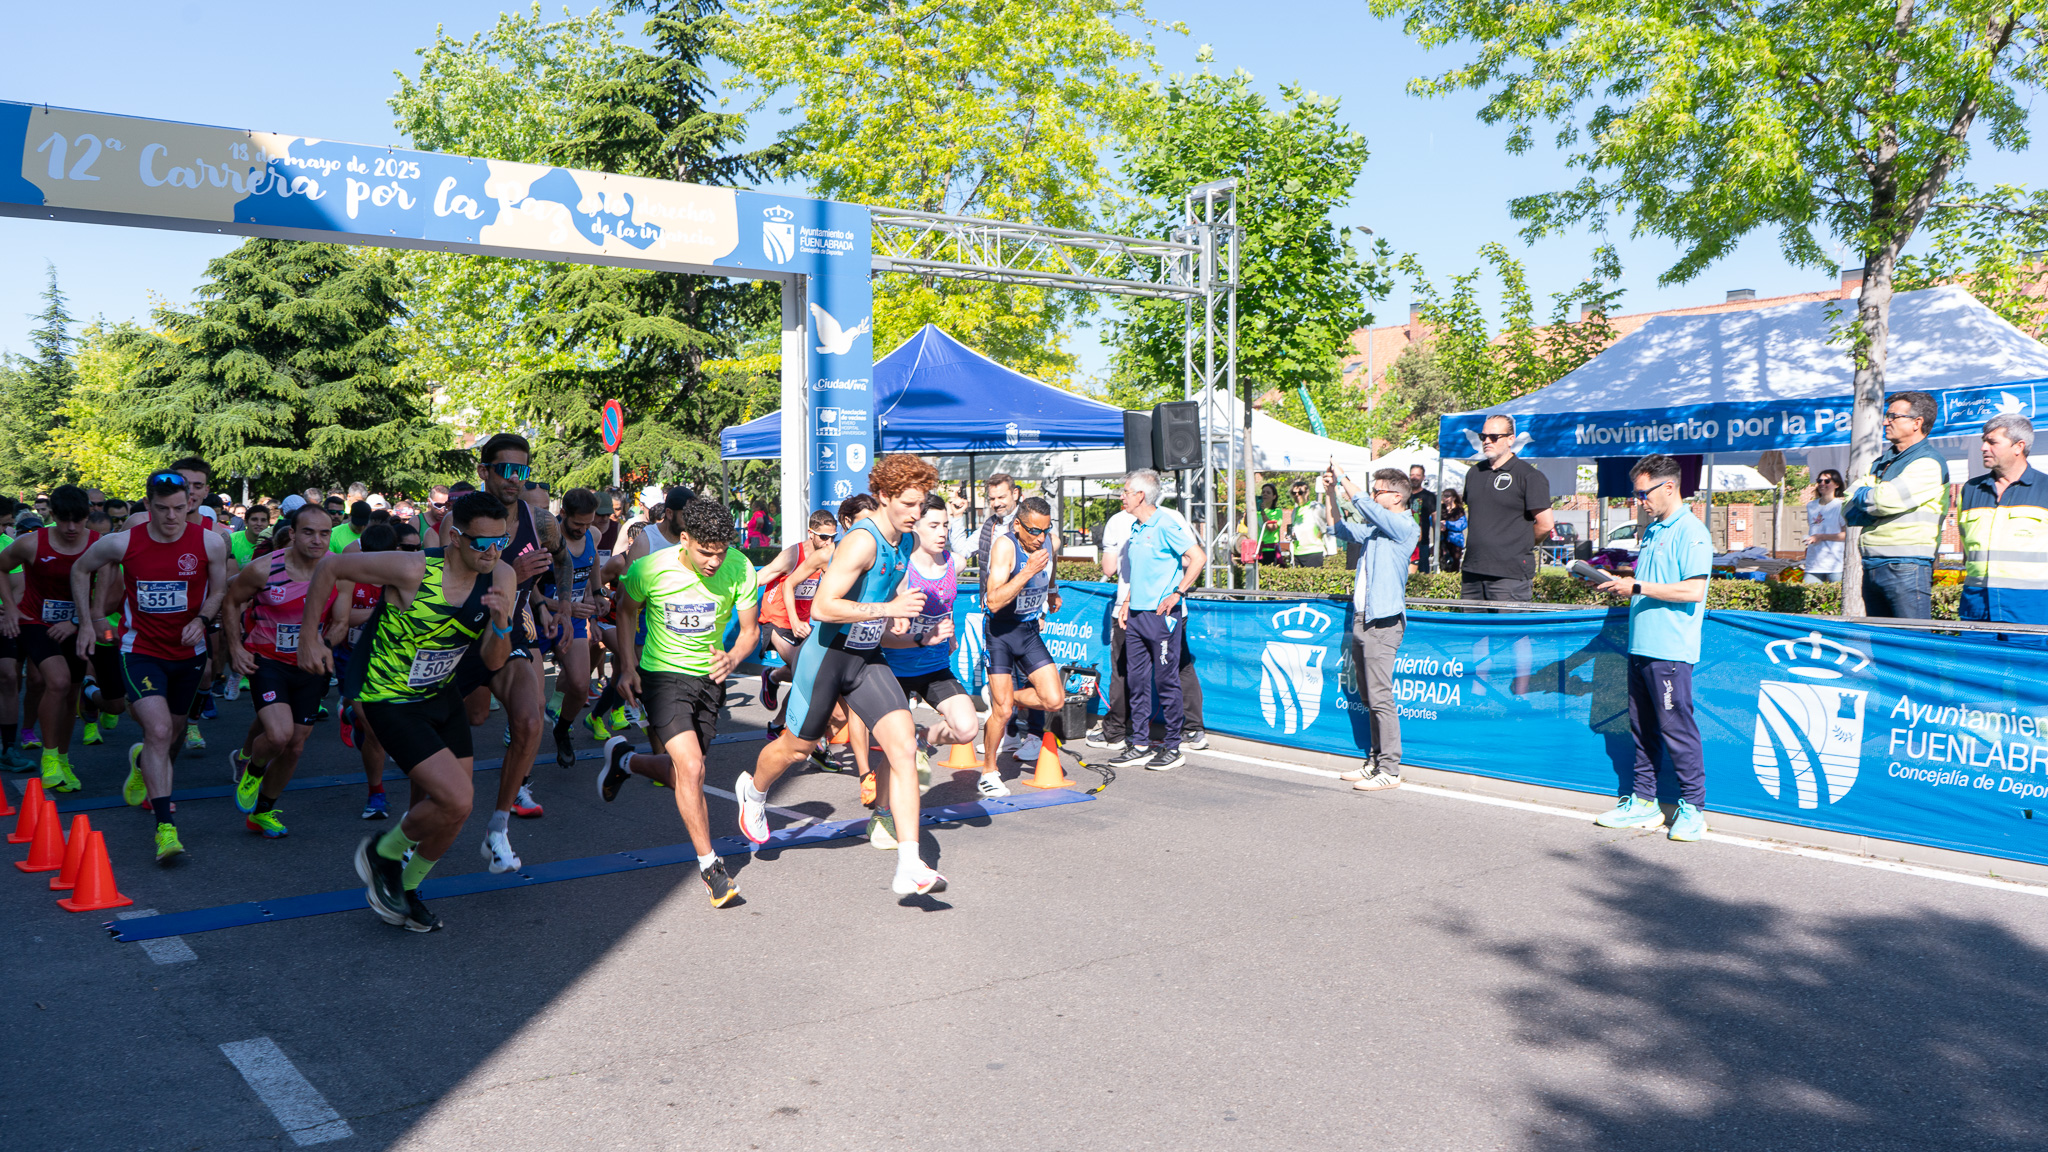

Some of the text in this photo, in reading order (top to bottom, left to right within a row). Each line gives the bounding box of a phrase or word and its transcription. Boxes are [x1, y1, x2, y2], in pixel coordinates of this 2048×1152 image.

[228, 141, 421, 180] 18 de mayo de 2025
[139, 143, 327, 200] Carrera
[346, 177, 417, 220] por
[433, 176, 485, 220] la
[495, 181, 568, 245] Paz
[603, 192, 630, 215] los
[637, 195, 717, 223] derechos
[591, 216, 717, 249] de la infancia
[800, 225, 854, 240] Ayuntamiento de
[800, 236, 854, 251] FUENLABRADA
[1950, 396, 1991, 410] Movimiento
[1951, 409, 1966, 420] por
[1977, 405, 1992, 415] Paz
[1575, 408, 1852, 446] Movimiento por la Pa
[148, 592, 176, 607] 551
[801, 585, 813, 595] 37
[1024, 594, 1043, 609] 587
[52, 609, 76, 620] 581
[680, 615, 700, 628] 43
[859, 625, 882, 642] 596
[1079, 620, 1093, 639] de
[1046, 639, 1087, 661] ABRADA
[422, 659, 455, 678] 502
[1442, 656, 1464, 678] de
[1337, 672, 1461, 707] FUABRADA
[1335, 697, 1437, 721] Conceja Deportes
[1888, 761, 1970, 787] Concejalía
[1973, 773, 1995, 791] de
